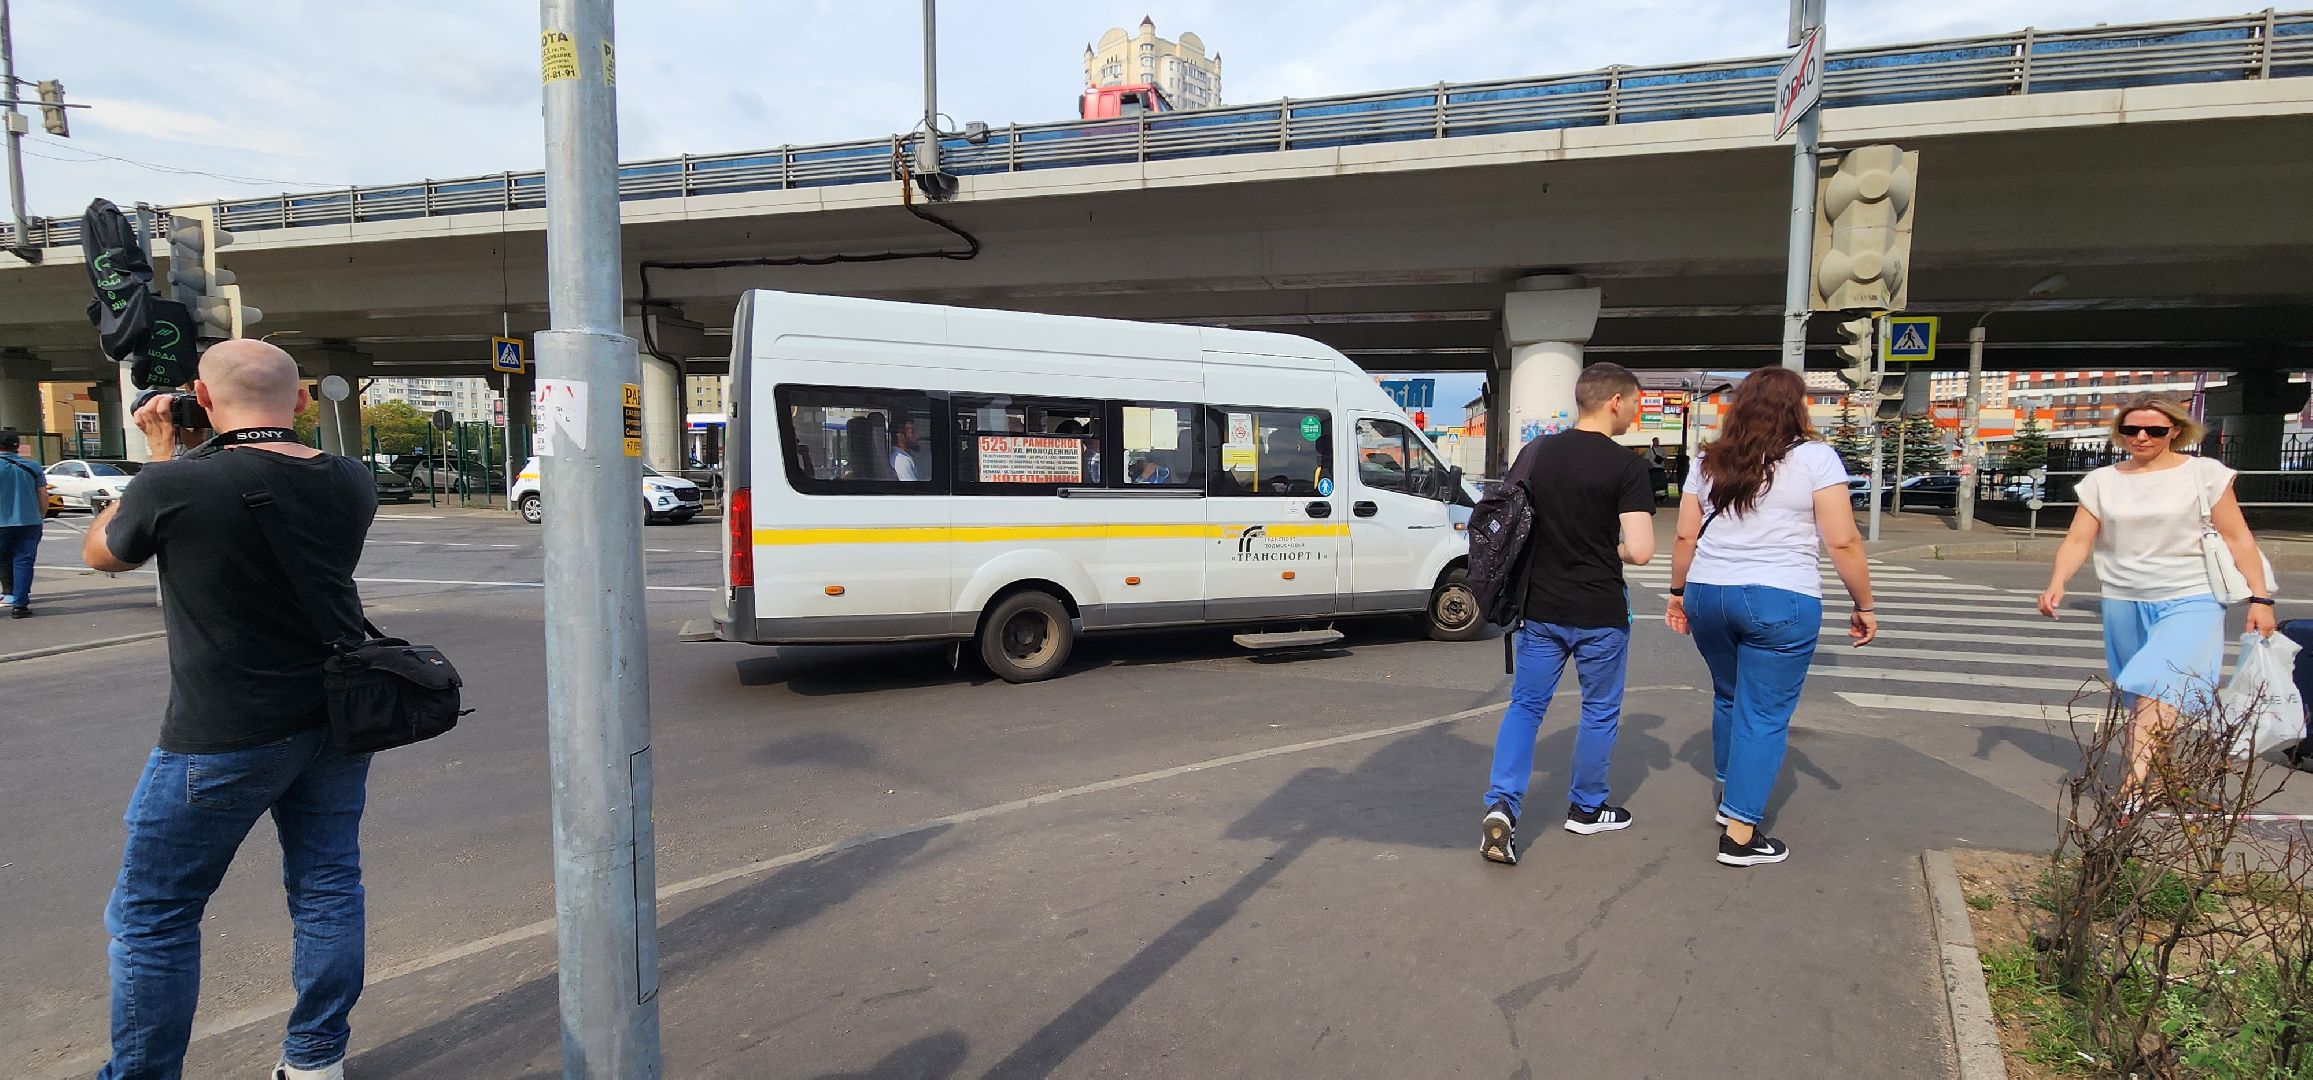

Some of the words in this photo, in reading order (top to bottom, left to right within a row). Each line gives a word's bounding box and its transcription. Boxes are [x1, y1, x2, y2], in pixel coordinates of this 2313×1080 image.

[111, 299, 127, 311] 3210
[236, 430, 283, 440] SONY
[981, 437, 1008, 452] 525
[1024, 438, 1079, 448] РАМЕНСКОЕ
